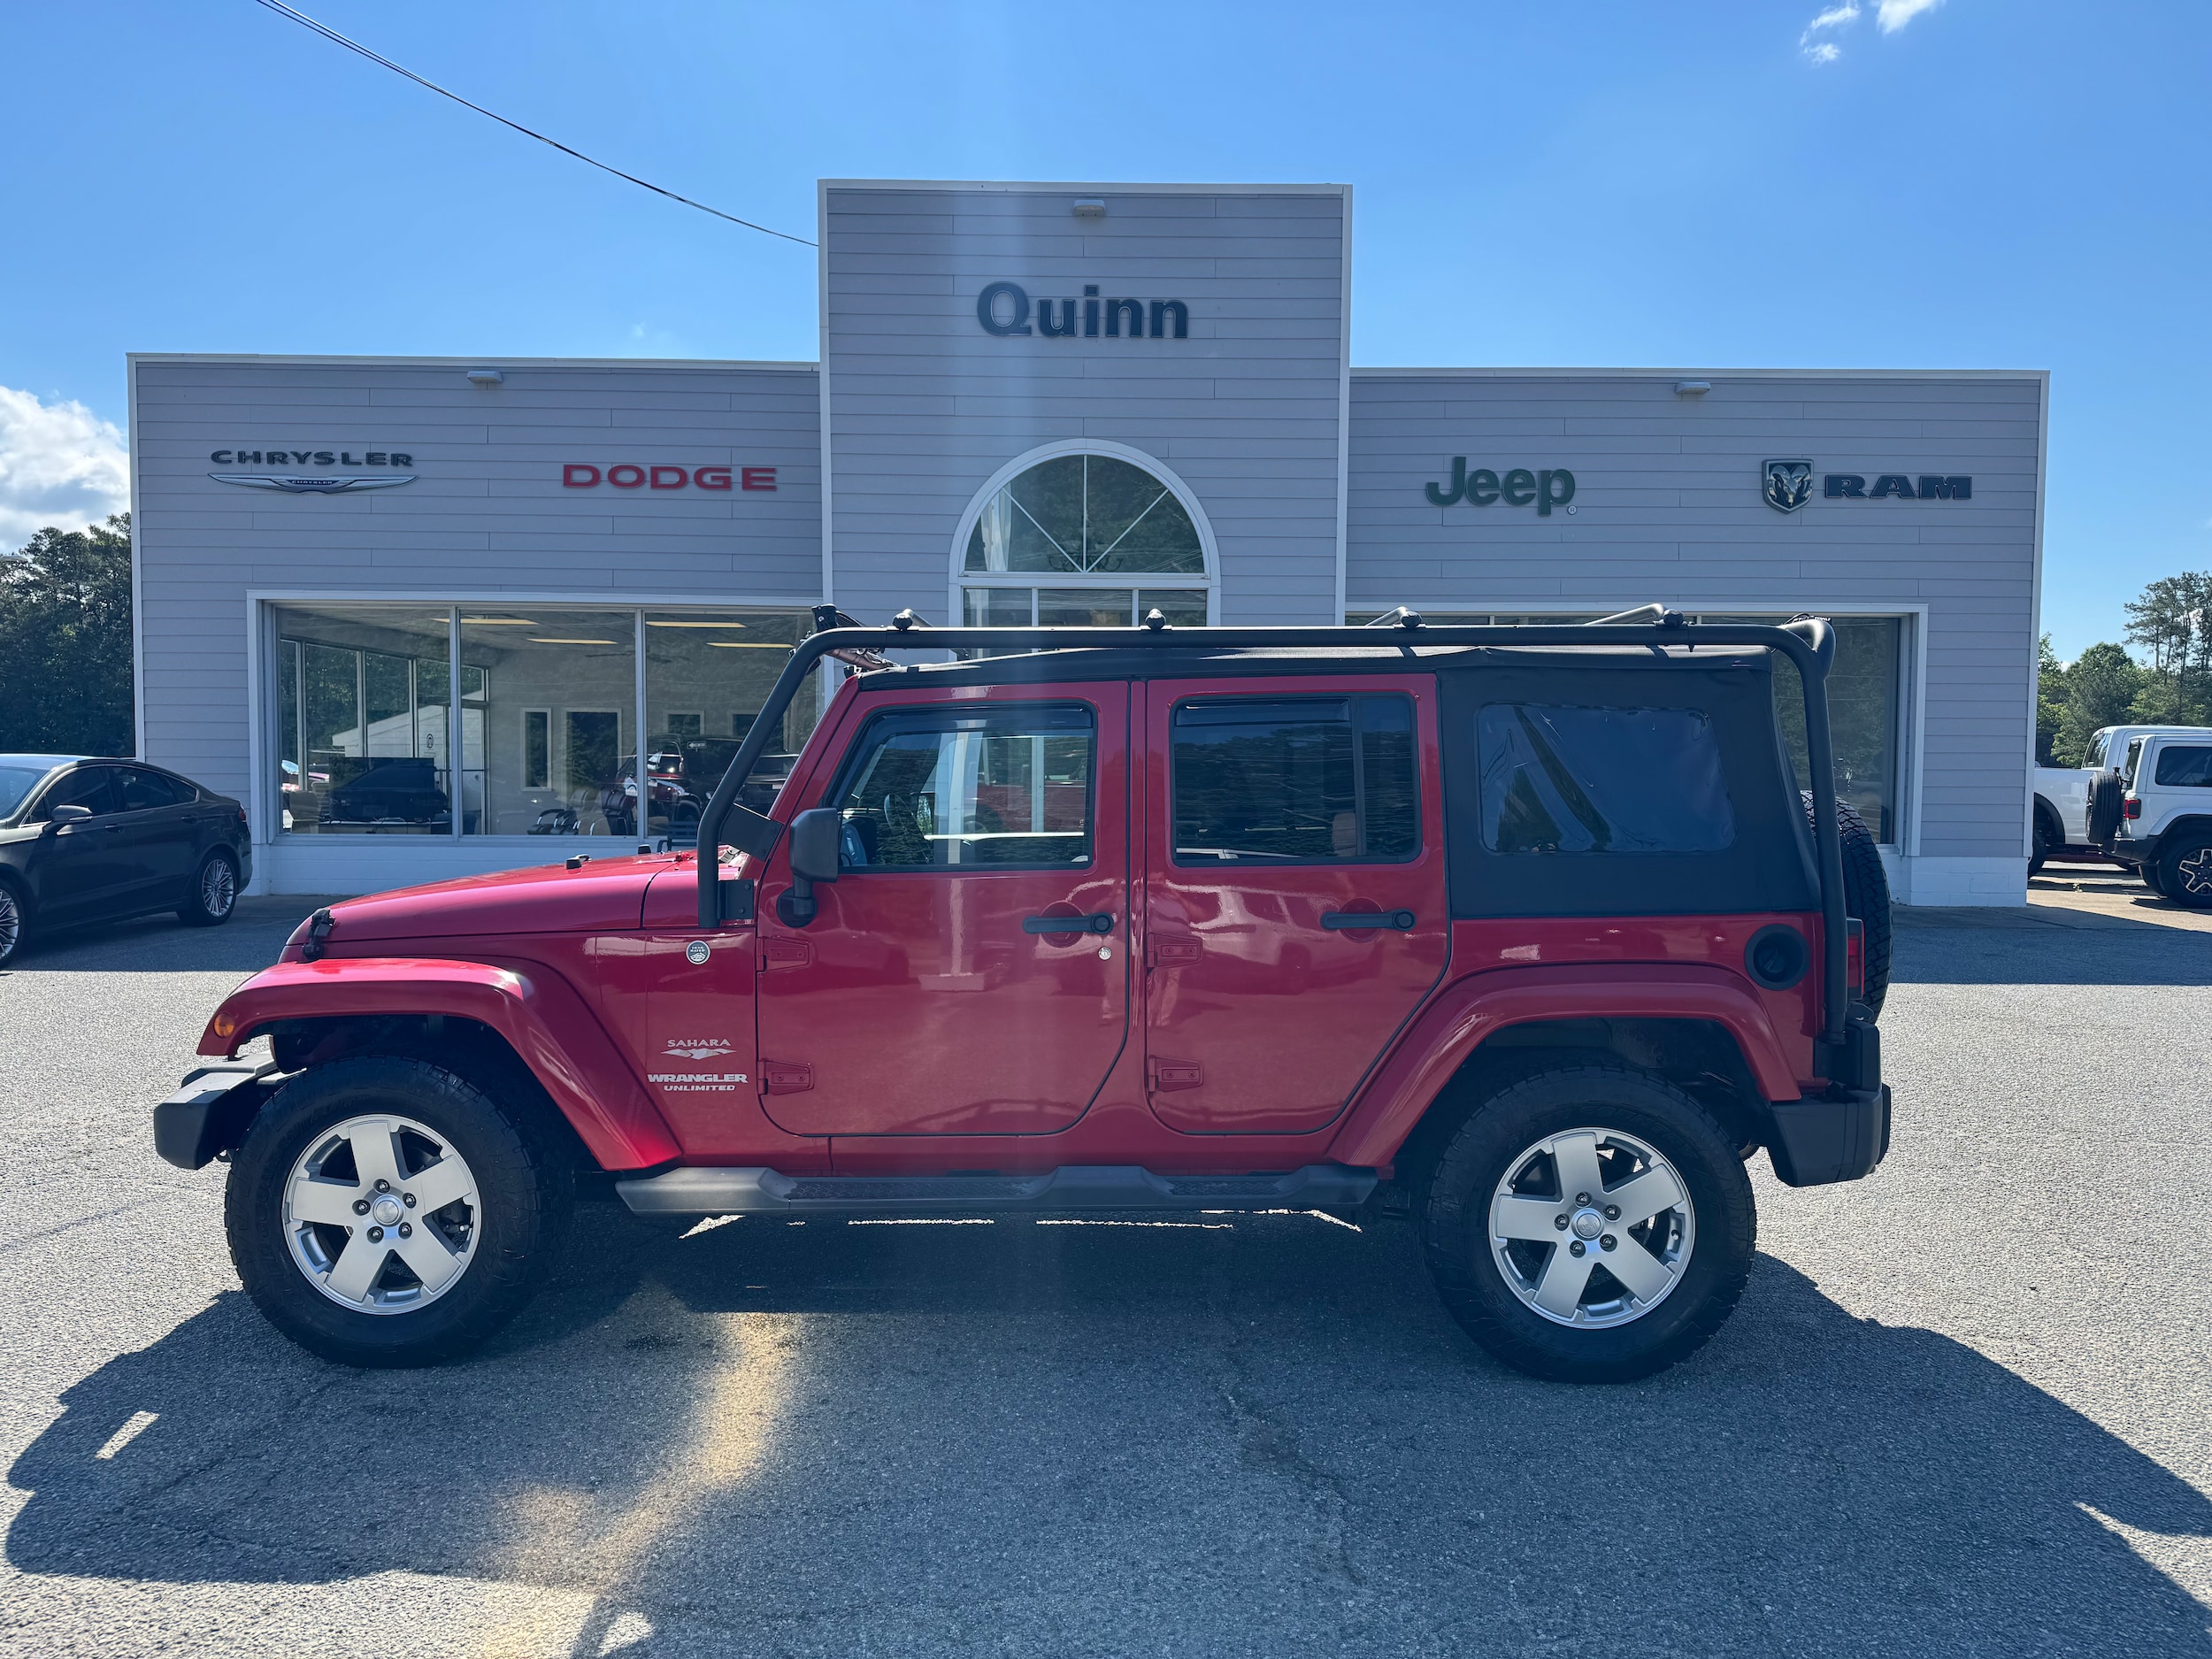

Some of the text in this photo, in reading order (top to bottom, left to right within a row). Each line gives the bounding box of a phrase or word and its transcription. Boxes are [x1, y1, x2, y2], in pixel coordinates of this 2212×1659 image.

[977, 280, 1188, 339] Quinn
[211, 449, 414, 467] CHRYSLER
[563, 464, 778, 492] DODGE
[1425, 456, 1576, 518] Jeep
[1824, 474, 1973, 500] RAM
[667, 1039, 731, 1048] SAHARA
[647, 1073, 749, 1084] WRANGLER
